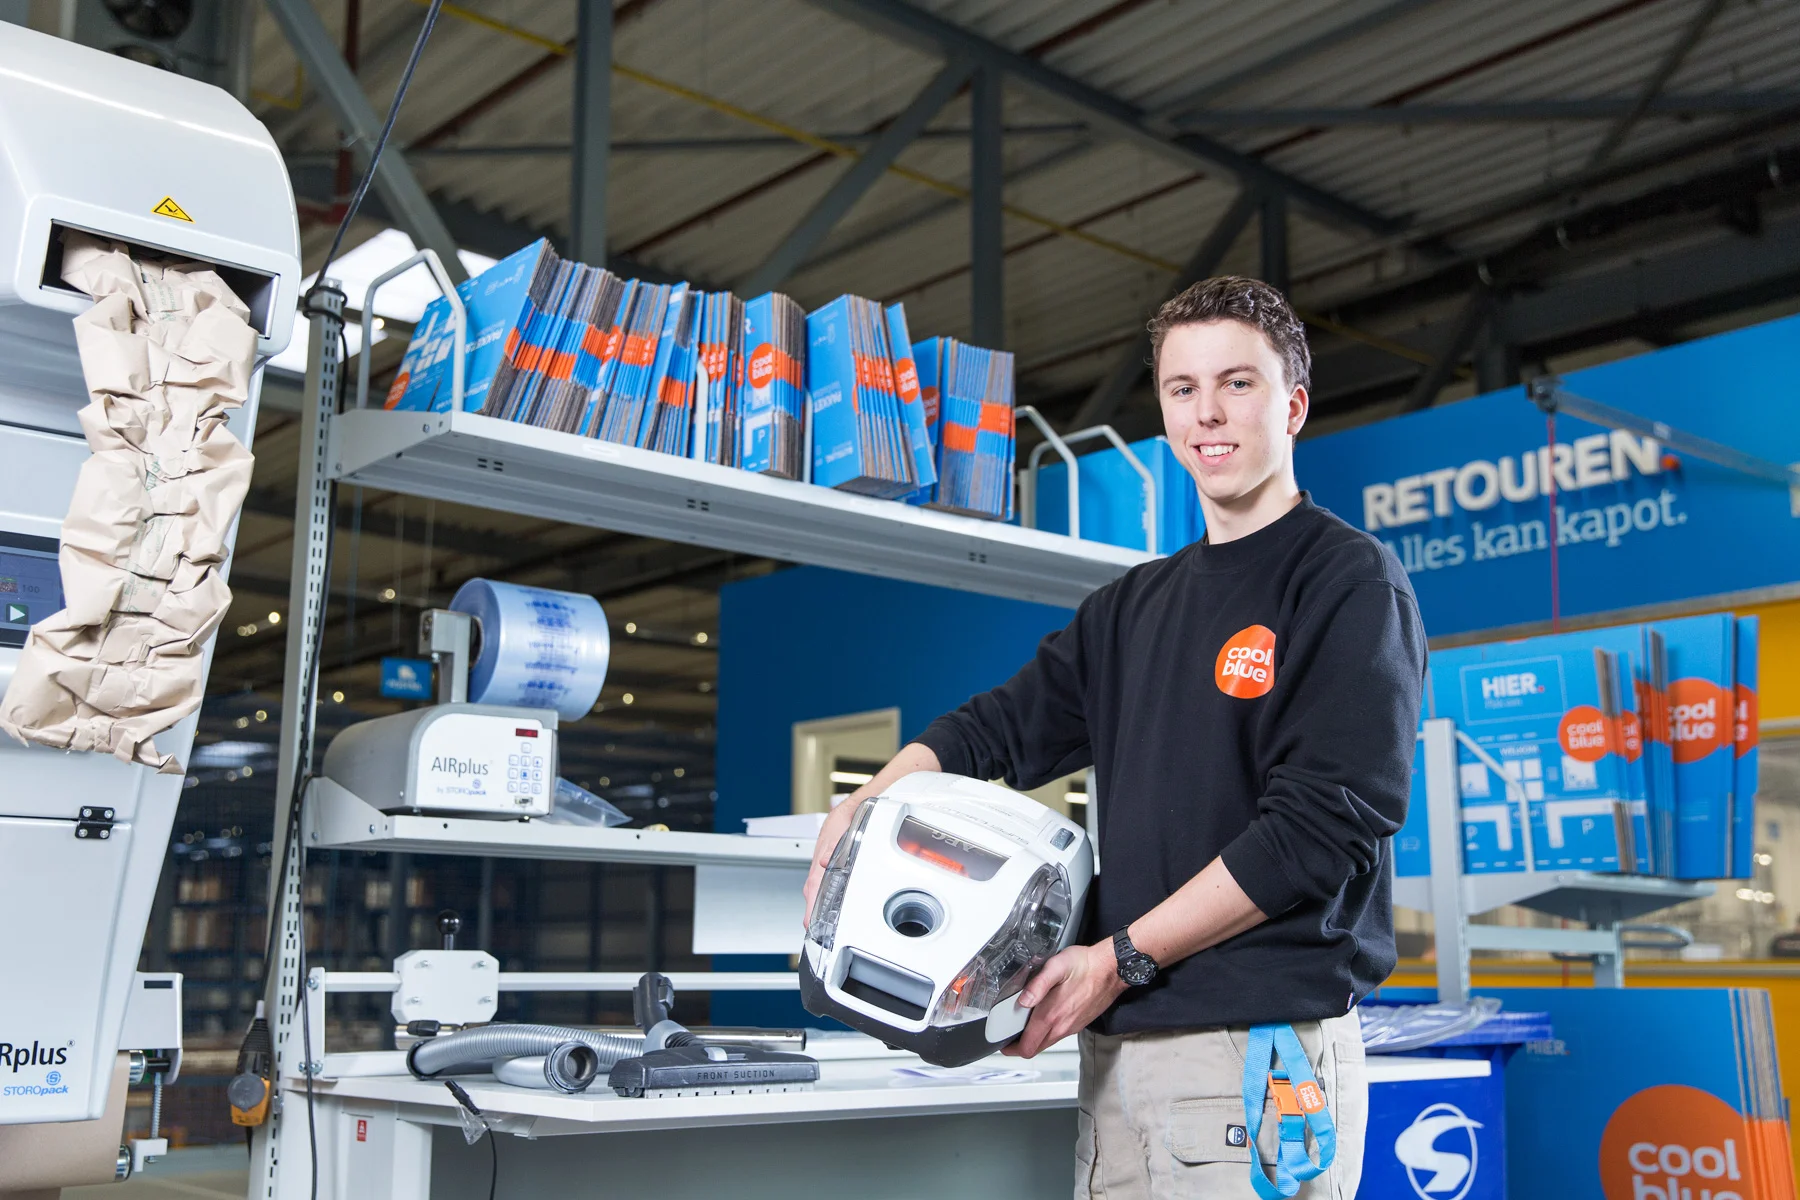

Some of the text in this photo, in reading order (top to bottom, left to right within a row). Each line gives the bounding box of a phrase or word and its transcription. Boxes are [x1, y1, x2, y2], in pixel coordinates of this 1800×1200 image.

[1472, 520, 1549, 562] kan
[1555, 488, 1687, 548] kapot.
[1227, 646, 1273, 666] cool
[1222, 659, 1267, 683] blue
[1566, 719, 1605, 736] cool
[1568, 734, 1605, 750] blue
[430, 756, 489, 778] AIRplus
[697, 1069, 775, 1081] FRONT SUCTION
[3, 1085, 69, 1097] STOROpack
[1299, 1086, 1312, 1109] blue
[1307, 1085, 1322, 1107] cool
[1627, 1138, 1742, 1181] cool
